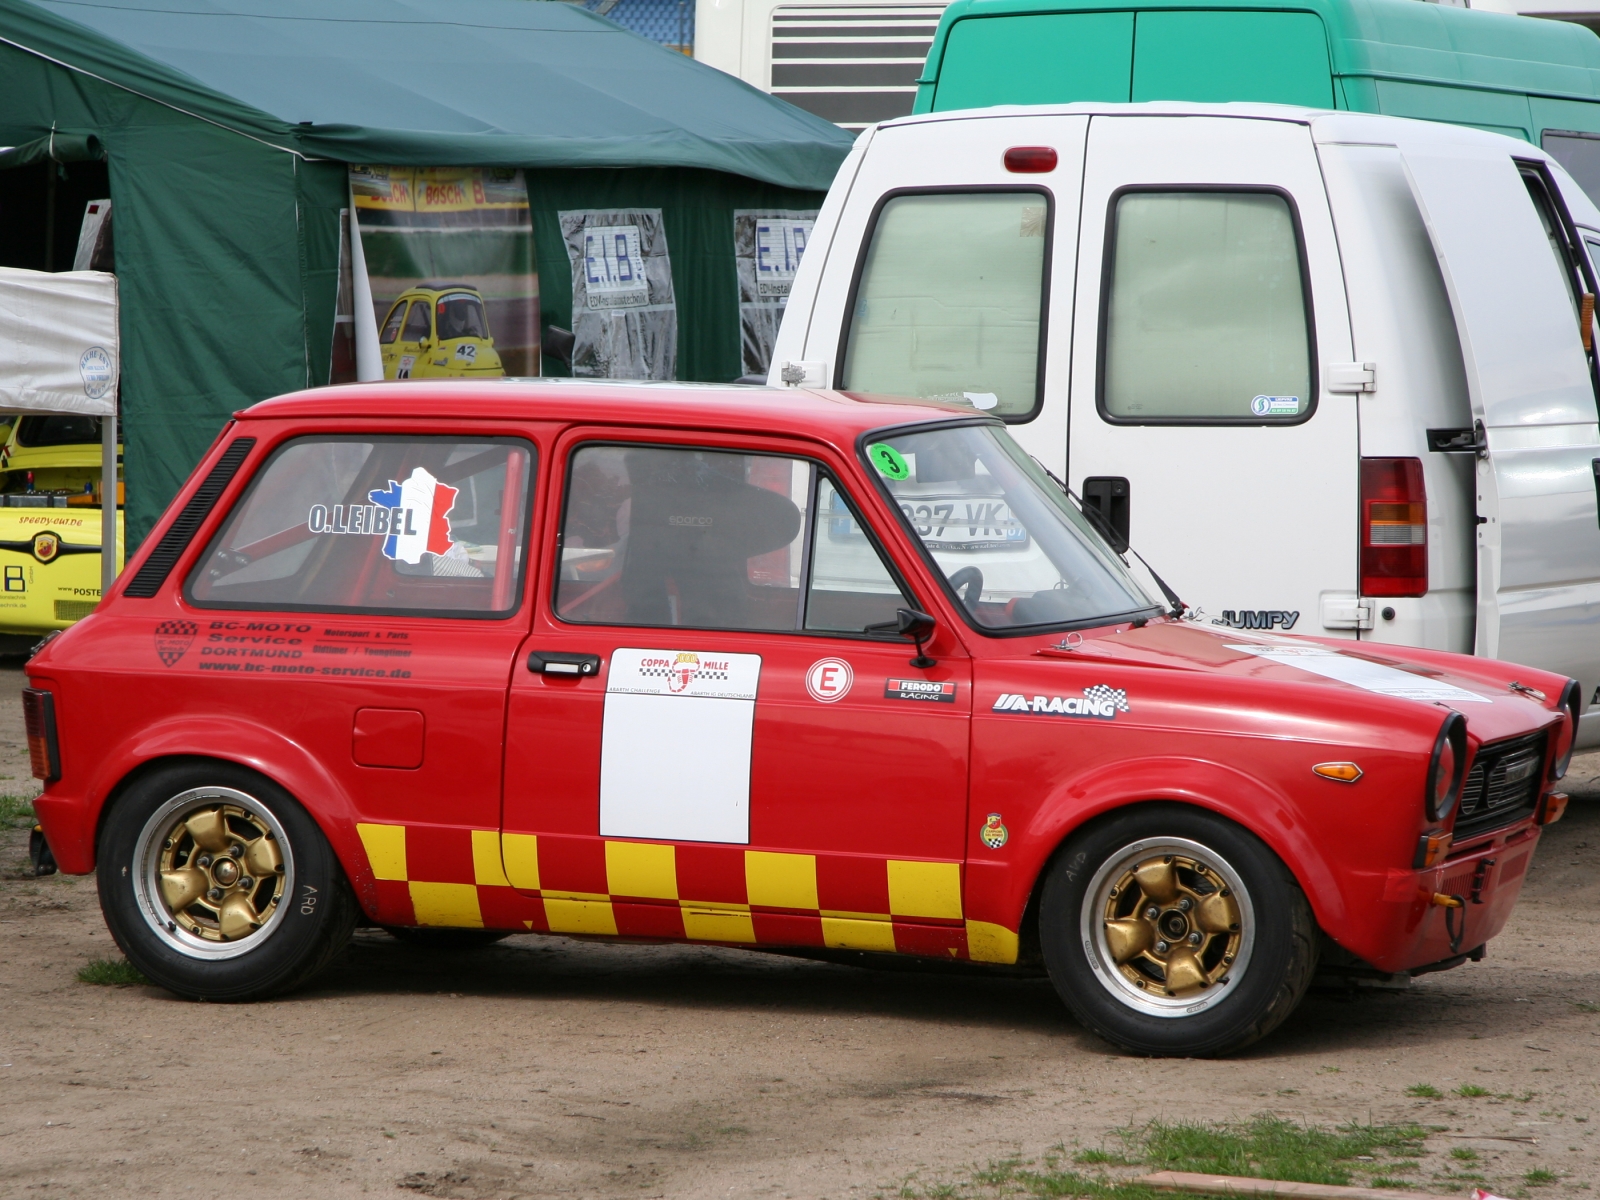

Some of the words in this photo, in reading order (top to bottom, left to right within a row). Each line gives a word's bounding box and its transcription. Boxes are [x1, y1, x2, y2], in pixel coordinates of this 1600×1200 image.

[426, 185, 463, 205] BOSCH
[456, 345, 476, 359] 42
[880, 450, 901, 474] 3
[308, 504, 417, 536] O.LEIBEL
[669, 515, 713, 526] sparco
[1212, 610, 1300, 630] JUMPY
[208, 621, 312, 633] BC-MOTO
[207, 633, 303, 646] Service
[324, 628, 370, 639] Motorsport
[386, 632, 409, 640] Parts
[201, 646, 303, 659] DORTMUND
[312, 644, 348, 655] Oldtimer
[364, 646, 413, 659] Youngtimer
[199, 660, 412, 679] www.bc-moto-service.de
[641, 658, 670, 668] COPPA
[703, 661, 730, 671] MILLE
[820, 667, 840, 692] E
[901, 682, 942, 692] FERODO
[900, 692, 940, 701] RACING
